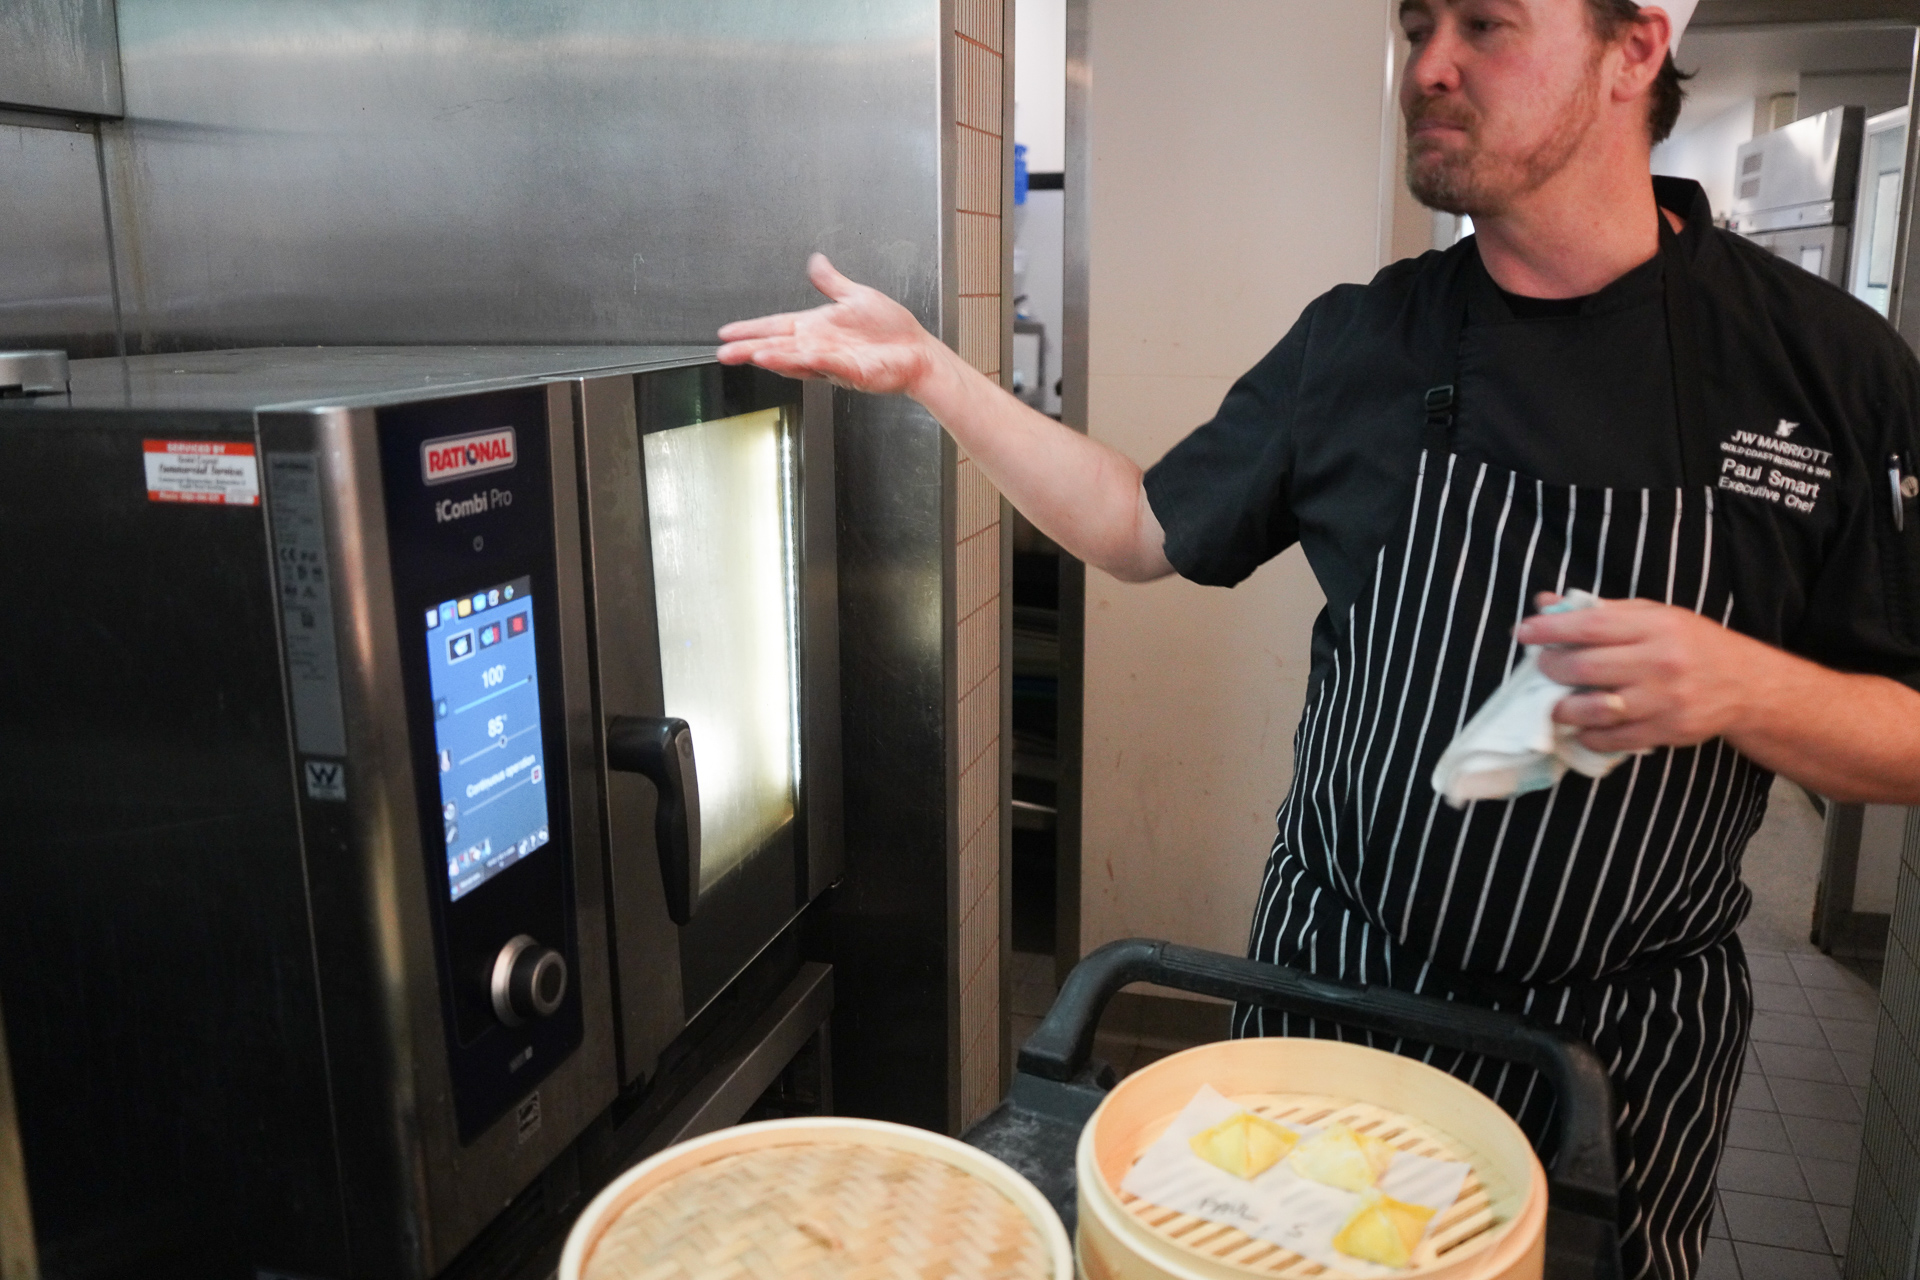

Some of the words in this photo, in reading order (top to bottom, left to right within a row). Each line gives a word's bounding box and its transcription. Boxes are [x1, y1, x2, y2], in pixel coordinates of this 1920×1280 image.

[428, 438, 511, 472] RATIONAL
[1720, 441, 1745, 455] GOLD
[1731, 430, 1757, 445] JW
[1757, 436, 1833, 464] MARRIOTT
[1718, 475, 1781, 503] Executive
[1784, 493, 1816, 515] Chef
[1721, 457, 1763, 482] Paul
[1768, 469, 1820, 499] Smart
[435, 491, 488, 524] iCombi
[490, 488, 513, 508] Pro
